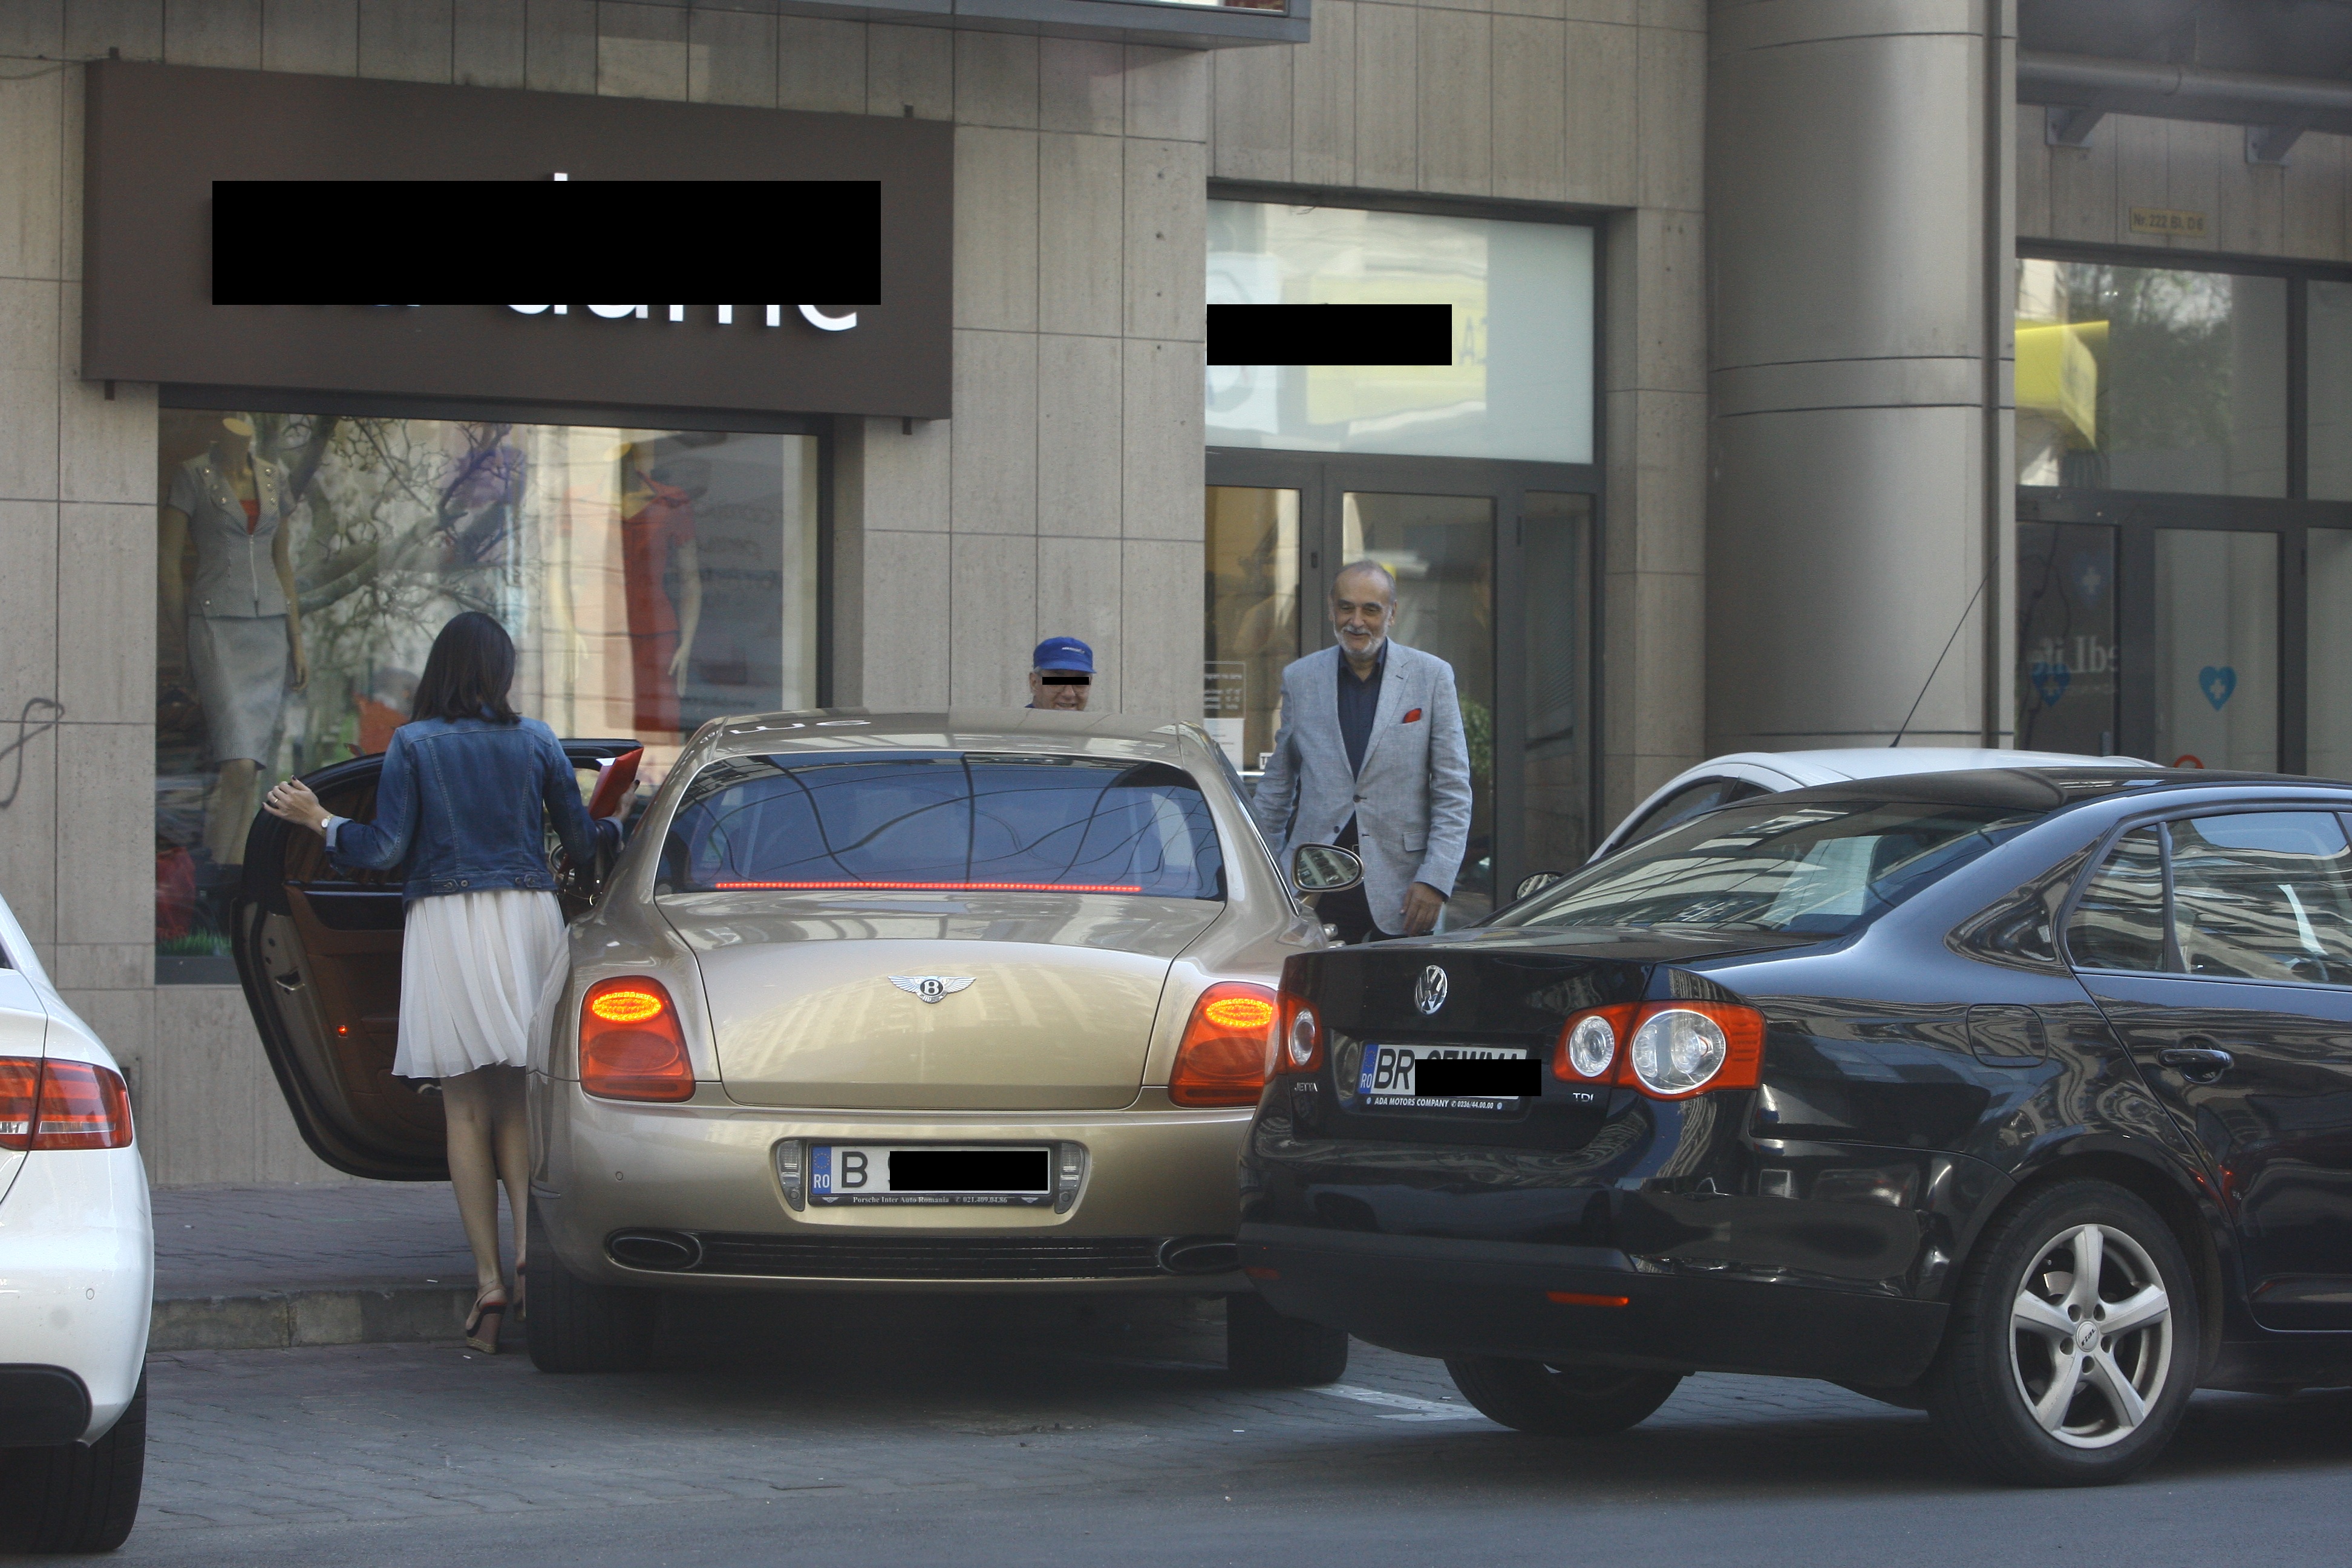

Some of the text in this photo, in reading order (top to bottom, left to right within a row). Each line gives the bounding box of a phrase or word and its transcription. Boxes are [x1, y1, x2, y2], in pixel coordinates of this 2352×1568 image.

[2149, 214, 2167, 228] 222
[1374, 1048, 1416, 1089] BR
[1294, 1082, 1318, 1092] JETTA
[1361, 1073, 1373, 1088] RO
[1374, 1097, 1388, 1105] ADA
[1389, 1097, 1416, 1106] MOTORS
[1416, 1099, 1449, 1108] COMPANY
[1572, 1093, 1594, 1103] TDI
[841, 1151, 868, 1188] B
[814, 1174, 831, 1189] RO
